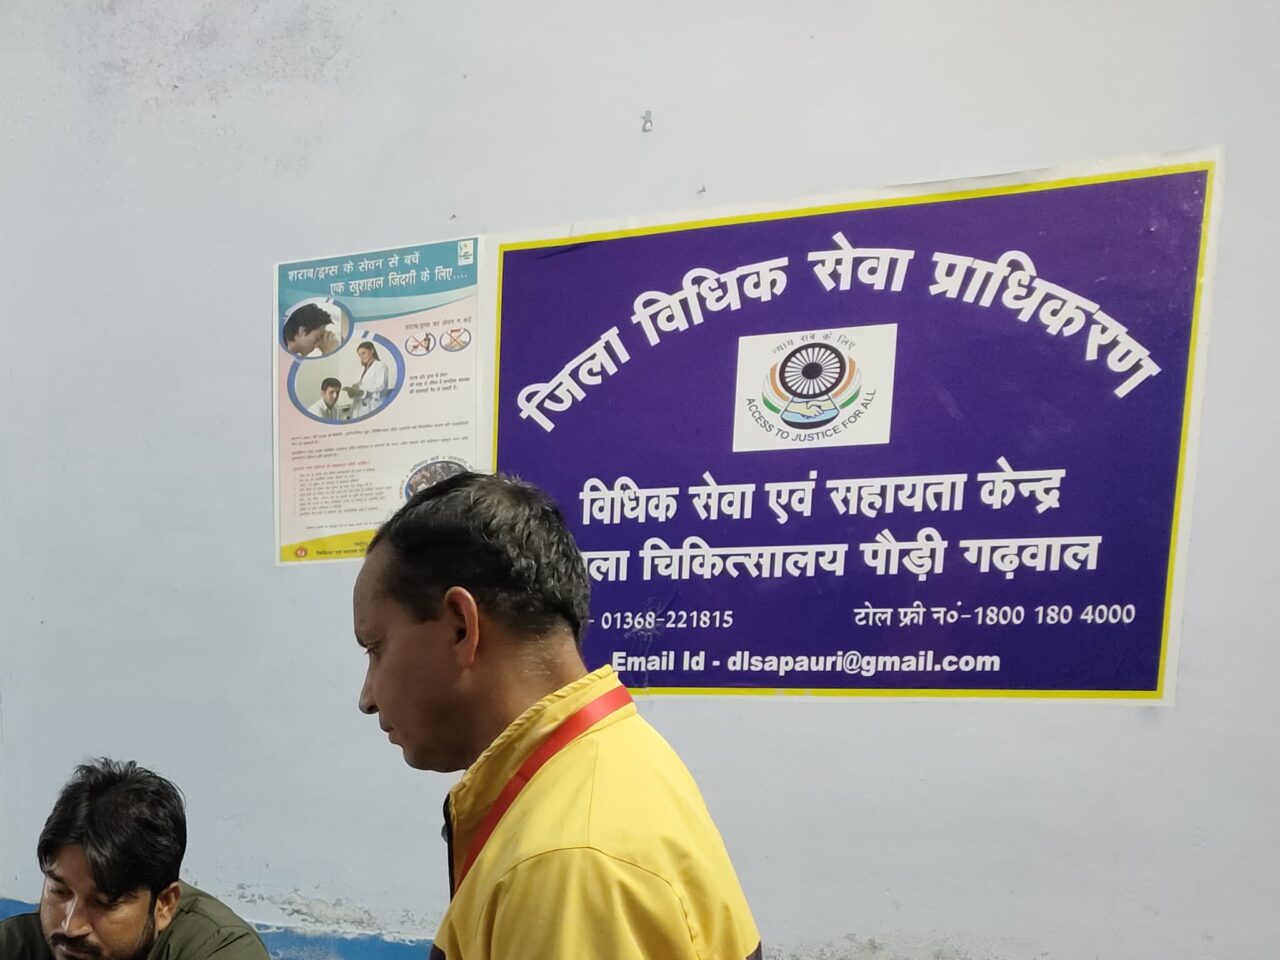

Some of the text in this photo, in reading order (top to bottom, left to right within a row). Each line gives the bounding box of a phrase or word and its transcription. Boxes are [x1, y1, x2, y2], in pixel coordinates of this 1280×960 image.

[343, 260, 354, 274] के
[358, 258, 384, 272] सेवन
[388, 254, 399, 268] से
[330, 282, 345, 296] एक
[349, 276, 384, 297] खुशहाल
[421, 267, 431, 282] के
[517, 231, 1162, 433] जिला विधिक सेवा प्राधिकरण
[745, 389, 877, 442] ACCESS TO JUSTICE FOR ALL
[579, 456, 1066, 525] विधिक सेवा एवं सहायता केन्द्र
[580, 527, 1102, 582] ला चिकित्सालय पौड़ी गढ़वाल
[601, 611, 734, 630] 01368-221815
[854, 602, 893, 627] टोल
[898, 601, 926, 627] फ्री
[1035, 605, 1073, 625] 180
[1080, 604, 1136, 624] 4000
[612, 651, 674, 671] Email
[683, 651, 705, 671] Id
[727, 650, 1001, 677] dlsapauri@gmail.com
